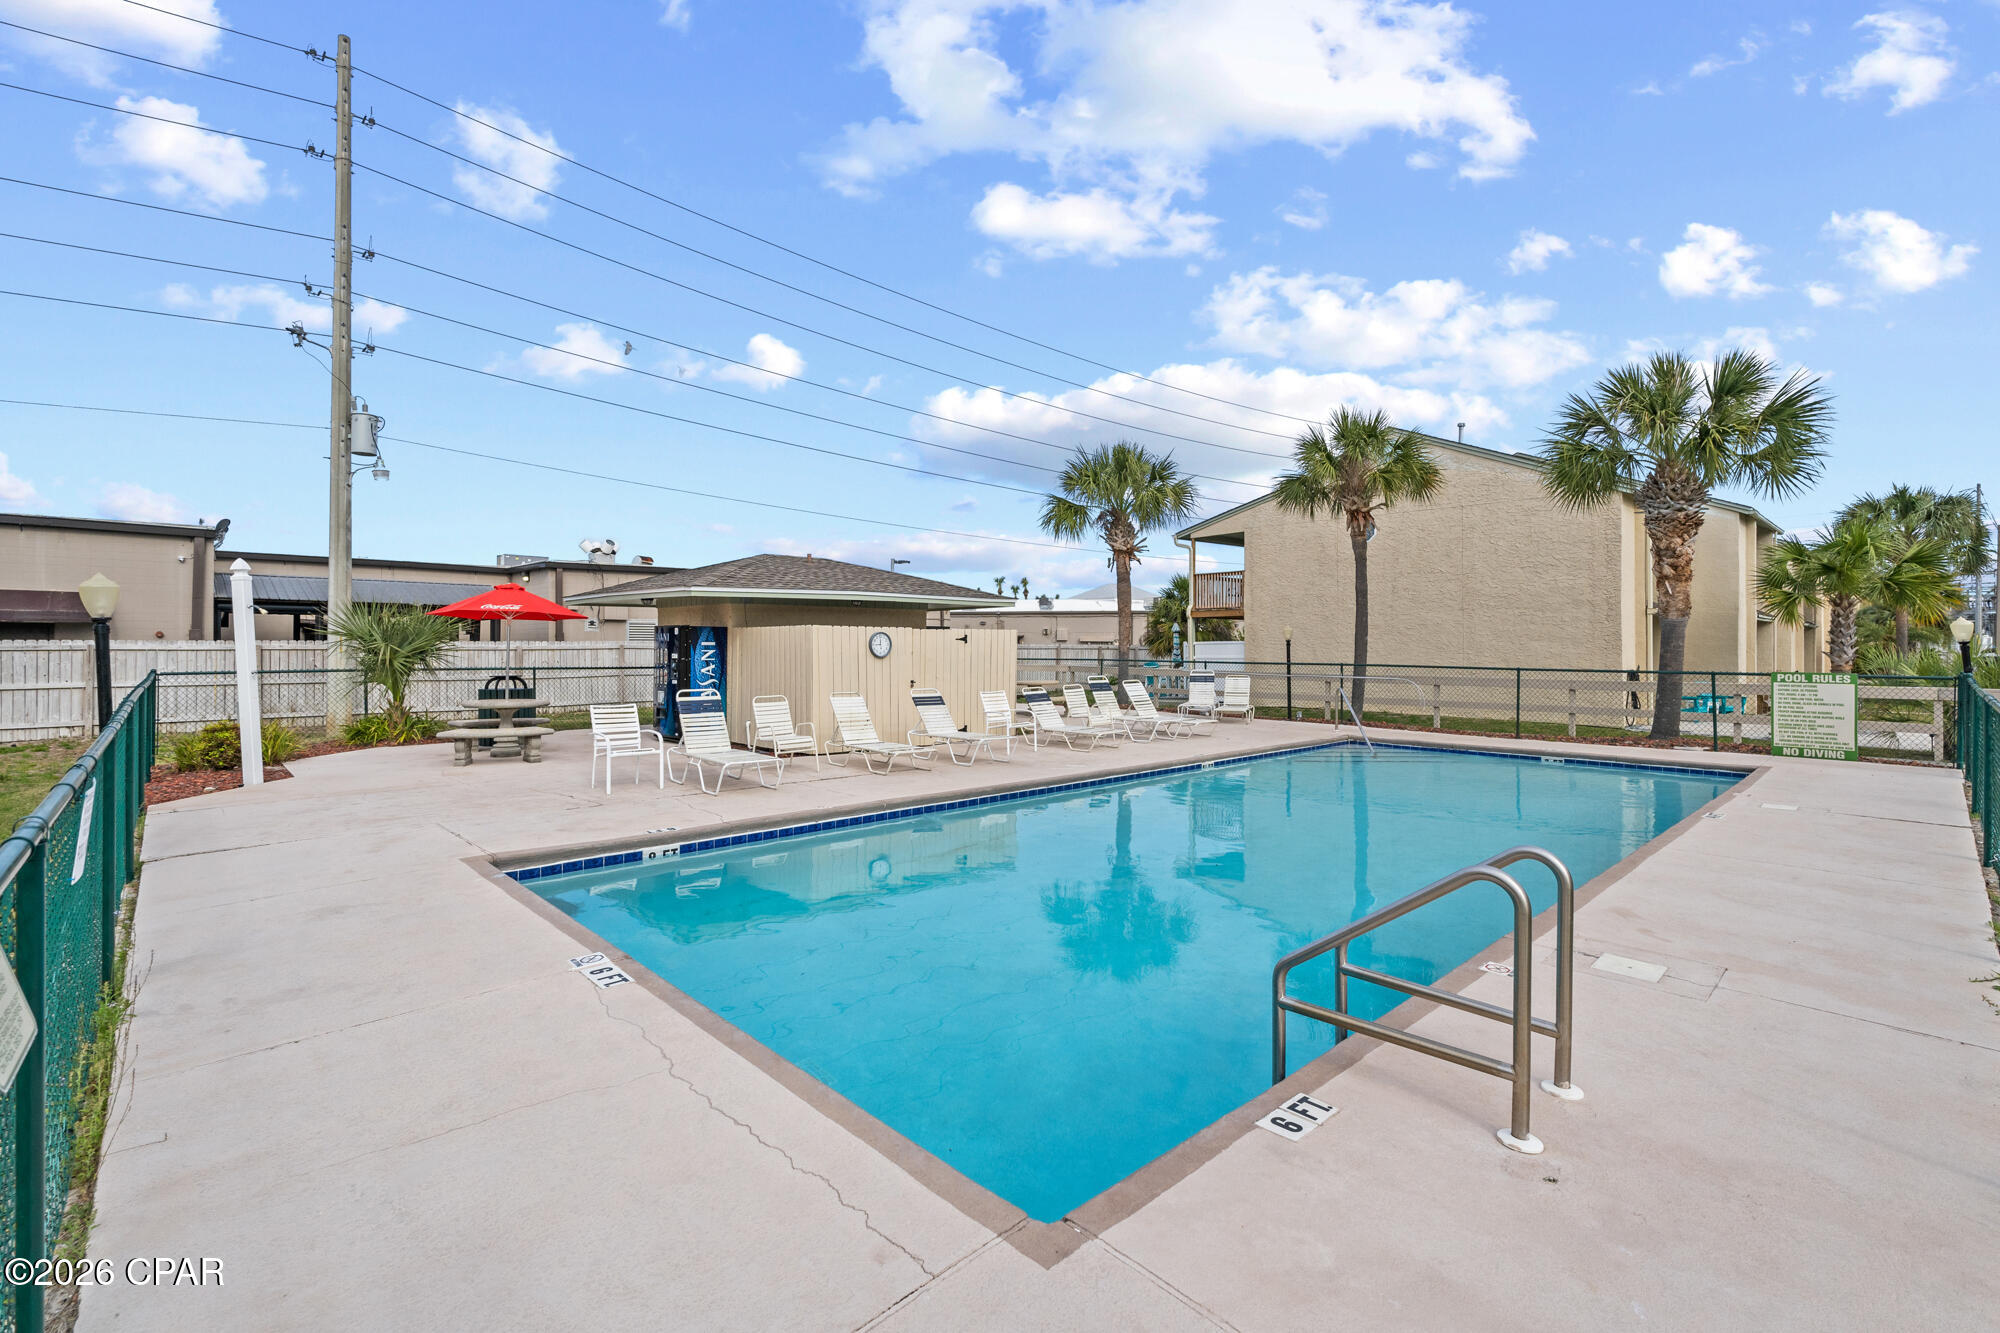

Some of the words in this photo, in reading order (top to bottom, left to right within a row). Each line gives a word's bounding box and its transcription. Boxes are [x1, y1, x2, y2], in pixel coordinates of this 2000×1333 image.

[1777, 673, 1808, 683] POOL
[1812, 674, 1851, 684] RULES
[1783, 747, 1799, 756] NO
[1803, 748, 1846, 759] DIVING
[589, 967, 613, 975] 6
[1270, 1116, 1303, 1133] 6
